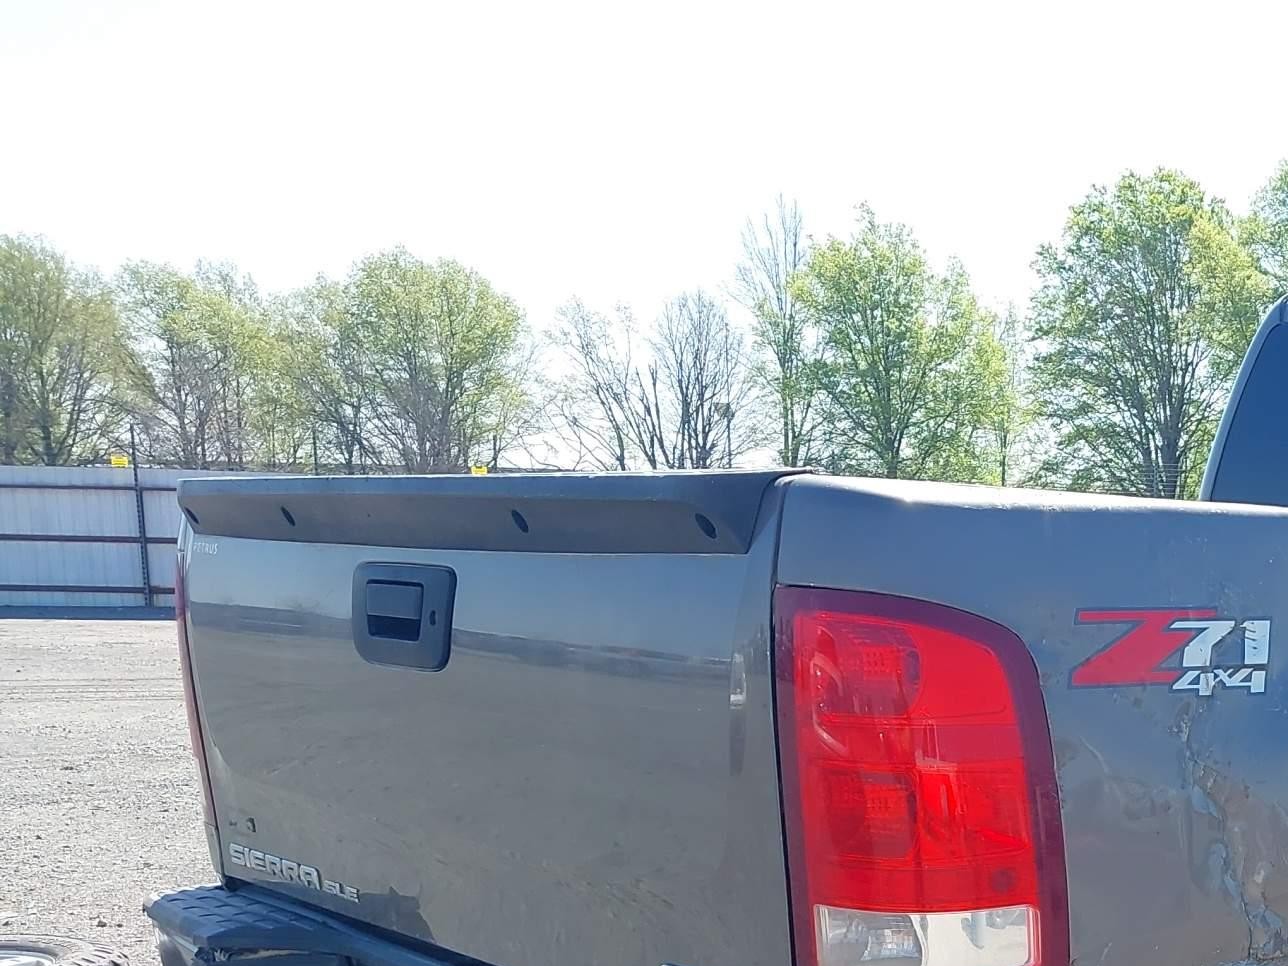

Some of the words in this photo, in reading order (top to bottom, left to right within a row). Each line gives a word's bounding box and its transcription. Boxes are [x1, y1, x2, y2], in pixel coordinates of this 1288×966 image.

[1072, 610, 1271, 686] Z71
[229, 843, 321, 890] SIERRA
[322, 880, 360, 904] SLE
